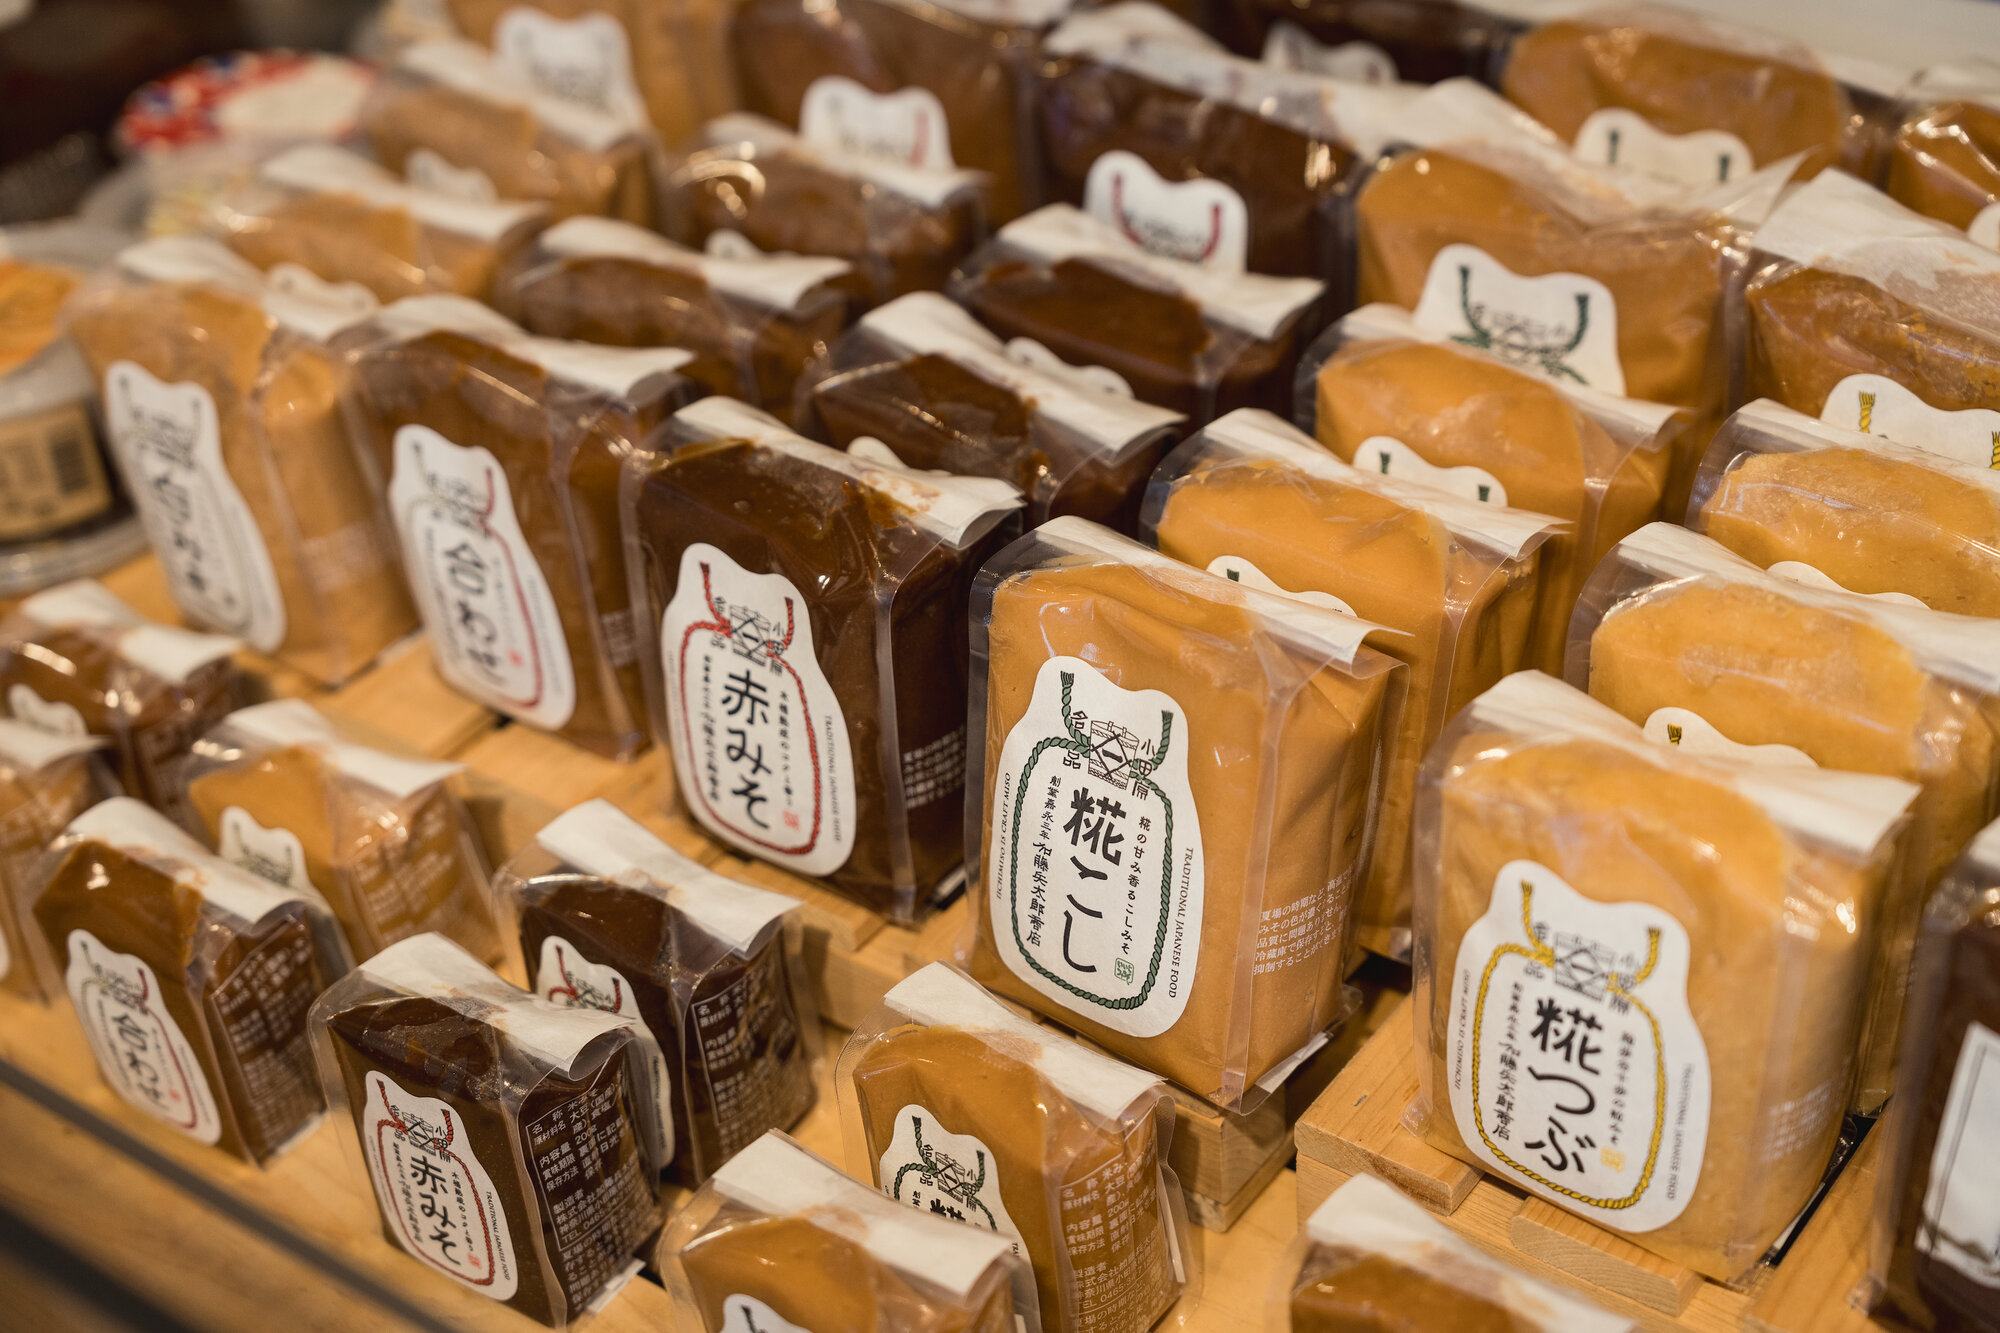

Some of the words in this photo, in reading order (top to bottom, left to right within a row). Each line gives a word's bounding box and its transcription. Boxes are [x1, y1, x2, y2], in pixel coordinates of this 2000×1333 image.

[721, 669, 772, 829] 赤みそ
[1003, 772, 1012, 798] MISO
[1001, 798, 1011, 833] CRAFT
[1063, 786, 1127, 973] 糀こし
[1179, 847, 1194, 918] TRADITIONAL
[1172, 918, 1186, 967] JAPANESE
[1168, 969, 1180, 999] FOOD
[1524, 998, 1604, 1174] 糀つぶ
[540, 1142, 572, 1168] 内容量
[542, 1153, 576, 1180] 賞味期限
[546, 1165, 579, 1192] 保存方法
[410, 1155, 462, 1266] 赤みそ
[486, 1191, 501, 1235] TRADITIONAL
[1066, 1214, 1103, 1233] 内容量
[562, 1231, 582, 1243] TEL
[1067, 1225, 1105, 1245] 賞味期限
[1068, 1240, 1106, 1257] 保存方法
[1111, 1234, 1131, 1253] 保存
